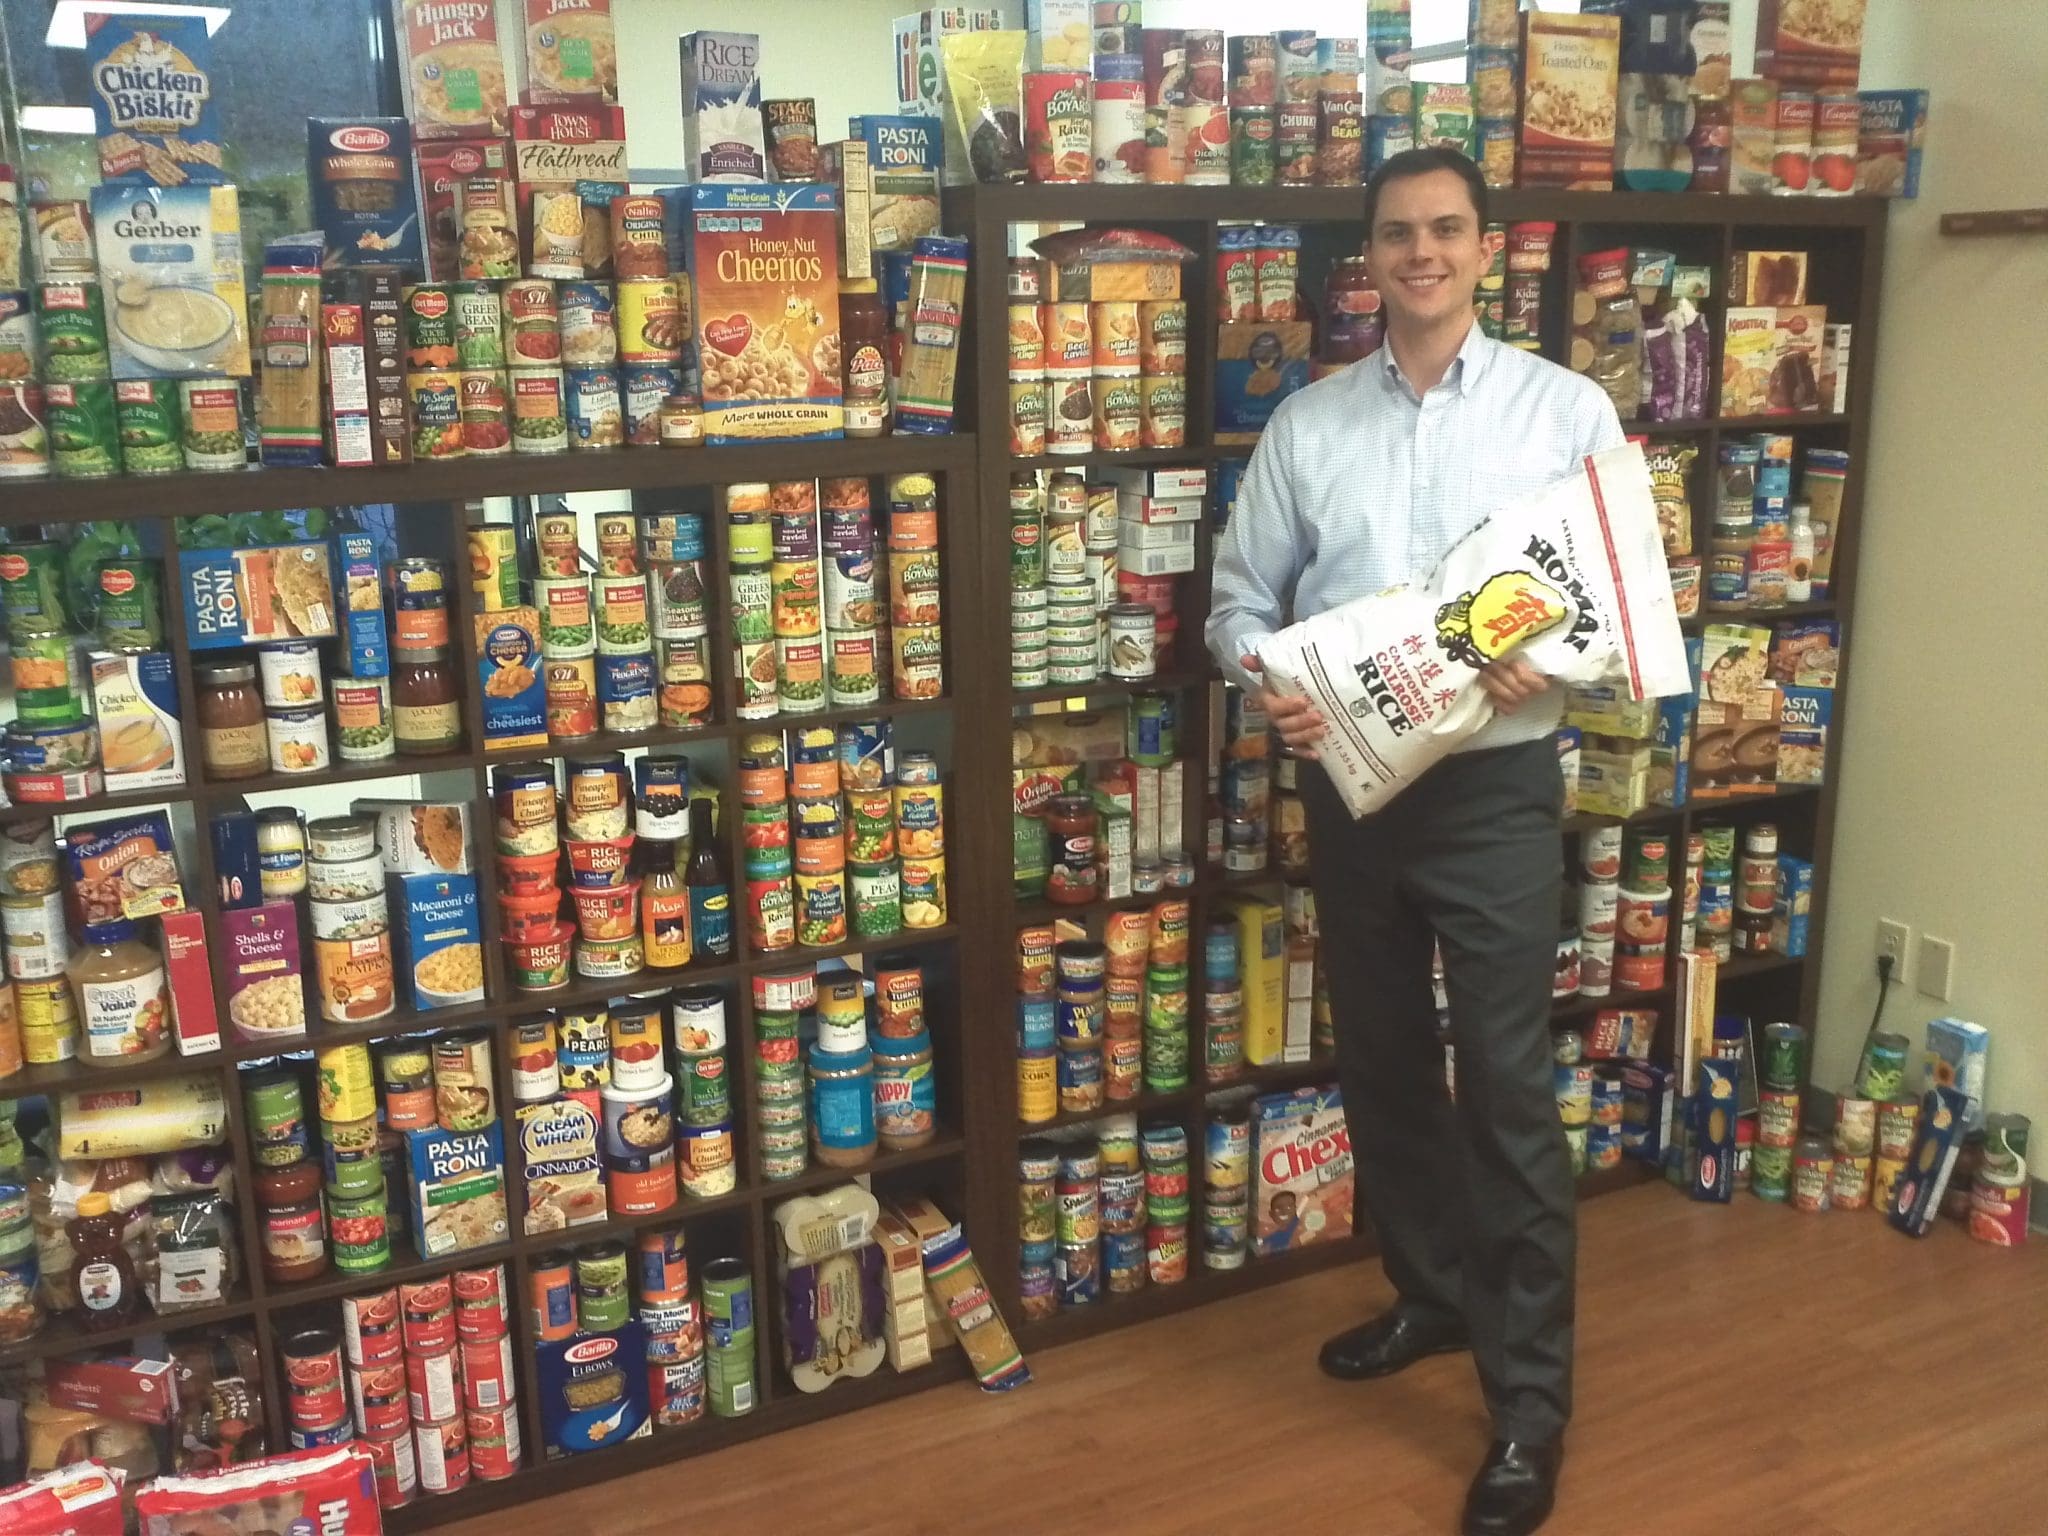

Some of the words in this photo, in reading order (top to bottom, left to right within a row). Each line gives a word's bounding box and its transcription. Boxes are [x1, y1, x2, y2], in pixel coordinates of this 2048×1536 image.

[415, 1, 488, 26] Hungry
[430, 19, 476, 46] Jack
[701, 39, 756, 67] RICE
[1541, 53, 1581, 69] Toasted
[1583, 56, 1608, 71] Oats
[100, 64, 202, 95] Chicken
[701, 65, 756, 83] DREAM
[113, 93, 194, 121] Biskit
[1862, 99, 1904, 114] PASTA
[551, 114, 589, 128] TOWN
[344, 131, 387, 146] Barilla
[550, 126, 593, 140] HOUSE
[877, 127, 929, 146] PASTA
[523, 145, 624, 169] Flatbread
[710, 156, 755, 169] Enriched
[881, 147, 926, 165] RONI
[328, 157, 363, 170] Whole
[364, 159, 395, 171] Grain
[537, 168, 608, 178] CRISPS
[627, 207, 660, 218] Nalley
[114, 220, 201, 239] Gerber
[625, 220, 662, 230] ORIGINAL
[631, 232, 660, 241] CHILI
[749, 237, 790, 257] Honey
[794, 238, 816, 252] Nut
[549, 256, 569, 264] Corn
[717, 249, 822, 283] Cheerios
[462, 303, 499, 315] GREEN
[68, 313, 93, 326] Peas
[328, 313, 357, 333] Stove
[465, 315, 500, 326] BEANS
[336, 321, 355, 337] Top
[416, 336, 451, 346] CARROTS
[721, 411, 756, 426] More
[756, 410, 793, 420] WHOLE
[796, 410, 828, 420] GRAIN
[781, 533, 808, 542] ravioli
[832, 529, 859, 537] ravioli
[345, 538, 373, 548] PASTA
[347, 546, 372, 555] RONI
[737, 583, 769, 594] GREEN
[191, 566, 217, 634] PASTA
[214, 569, 238, 628] RONI
[740, 593, 770, 603] BEANS
[666, 614, 691, 623] Black
[1375, 651, 1427, 727] CALROSE
[1388, 645, 1435, 720] CALIFORNIA
[99, 694, 138, 706] Chicken
[1353, 655, 1415, 738] RICE
[486, 714, 543, 730] cheesiest
[502, 713, 513, 721] the
[1022, 782, 1055, 800] Orville
[98, 841, 140, 872] Onion
[260, 853, 282, 864] Best
[590, 846, 621, 857] RICE
[759, 847, 785, 859] Diced
[583, 872, 607, 881] Chicken
[871, 883, 897, 897] PEAS
[411, 895, 462, 913] Macaroni
[464, 893, 475, 905] &
[579, 898, 607, 908] RICE
[424, 908, 464, 923] Cheese
[235, 931, 270, 946] Shells
[273, 930, 285, 942] &
[239, 942, 283, 957] Cheese
[530, 944, 561, 957] RICE
[99, 999, 137, 1012] Value
[102, 1012, 132, 1023] Natural
[875, 1082, 912, 1104] KIPPY
[201, 1124, 217, 1136] 31
[532, 1116, 586, 1135] CREAM
[534, 1129, 586, 1148] WHEAT
[428, 1133, 490, 1160] PASTA
[433, 1151, 487, 1177] RONI
[1261, 1129, 1353, 1186] Chex
[525, 1156, 600, 1181] CINNABON
[663, 1307, 690, 1320] Moore
[577, 1343, 613, 1360] Barilla
[572, 1359, 614, 1378] ELBOWS
[666, 1365, 691, 1378] Dinty
